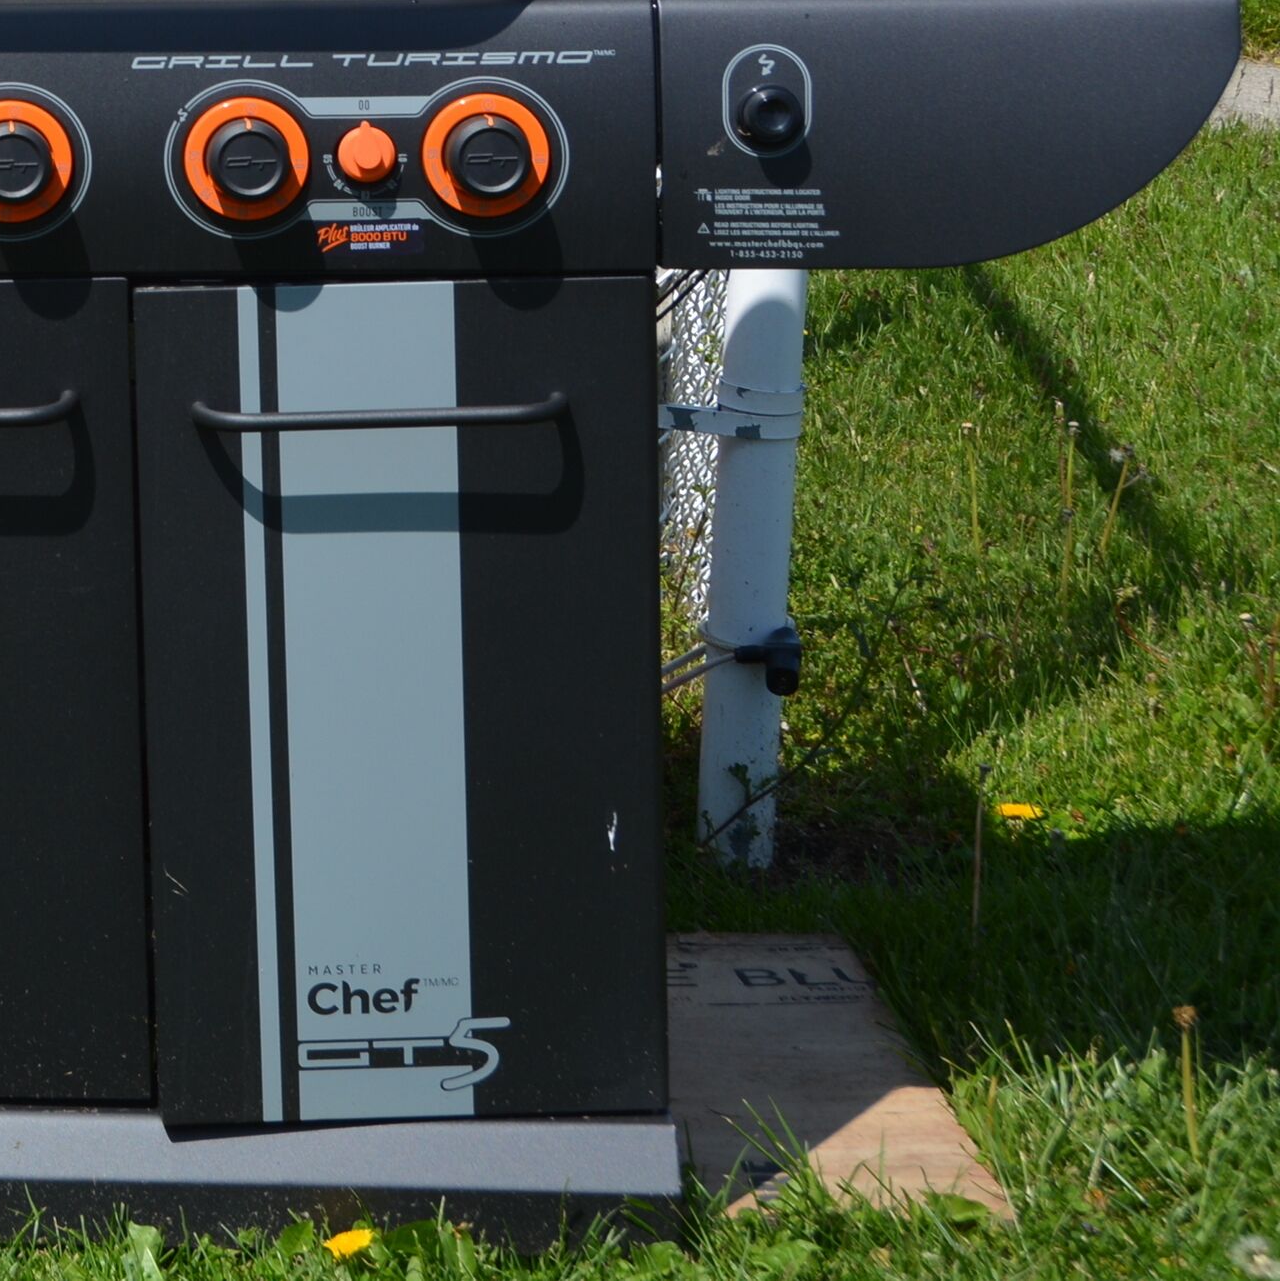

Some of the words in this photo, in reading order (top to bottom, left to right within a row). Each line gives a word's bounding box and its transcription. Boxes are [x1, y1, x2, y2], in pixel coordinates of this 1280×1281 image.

[131, 55, 315, 69] GRILL
[333, 51, 593, 67] TURISMO
[352, 206, 383, 218] BOOST
[317, 222, 349, 250] Plus
[351, 232, 381, 242] 8000
[383, 231, 407, 241] BTU
[709, 239, 824, 249] www.masterchefbbqs.com
[308, 964, 382, 975] MASTER
[307, 978, 420, 1015] Chef
